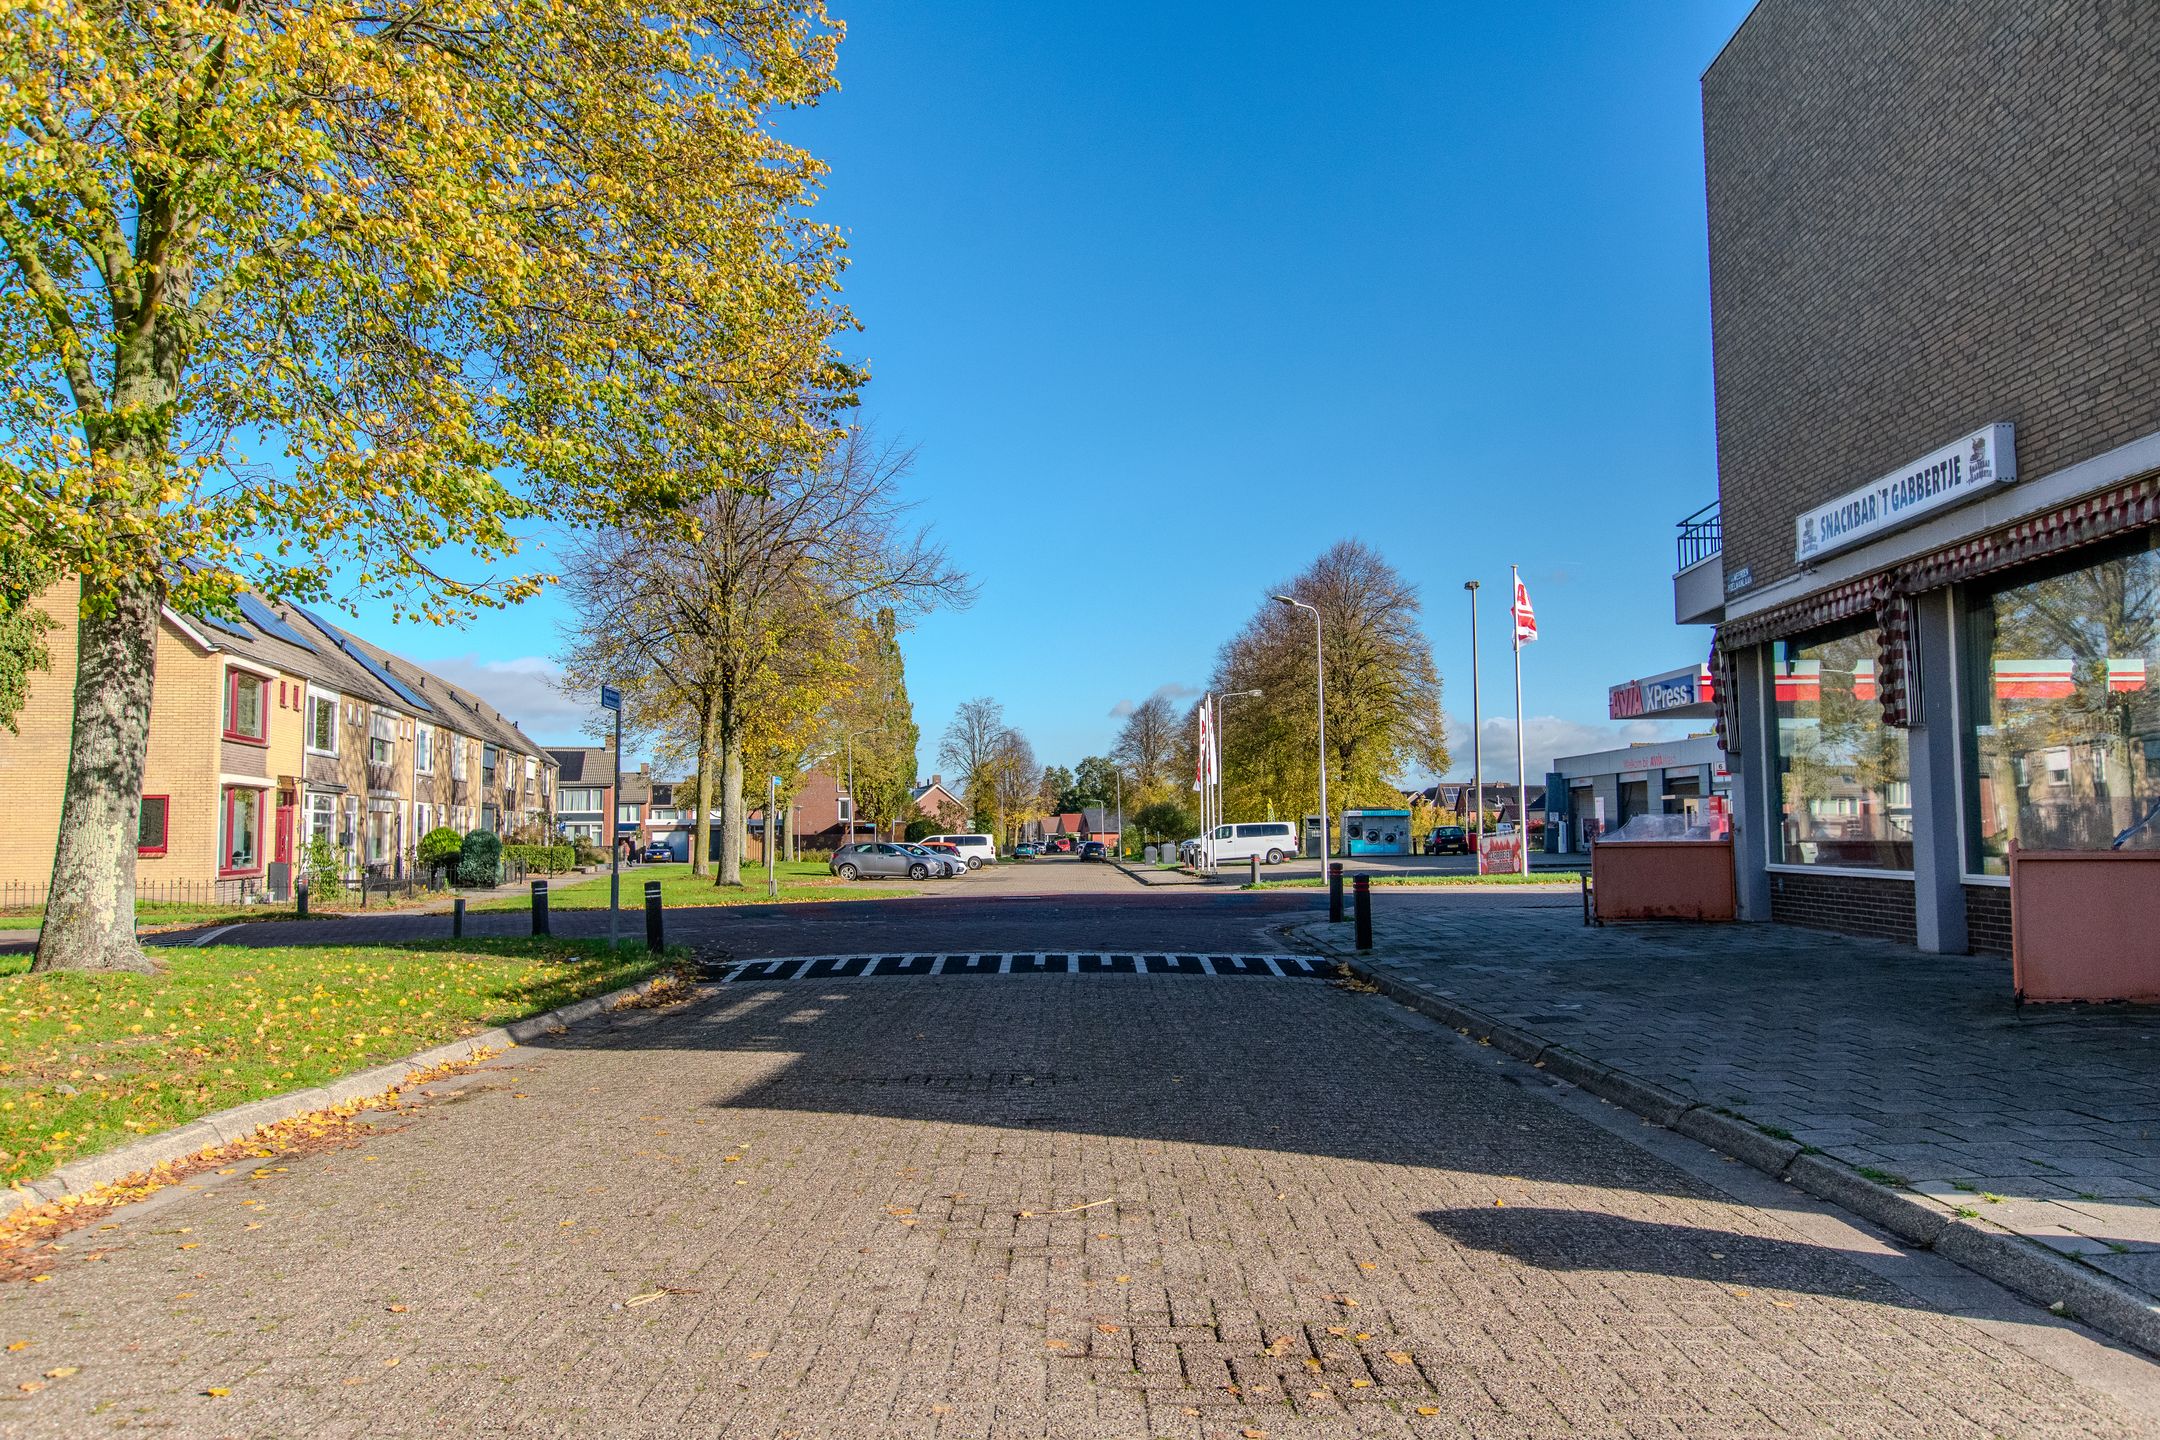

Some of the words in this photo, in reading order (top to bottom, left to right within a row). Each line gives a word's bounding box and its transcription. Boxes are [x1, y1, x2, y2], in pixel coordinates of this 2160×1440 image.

[1820, 494, 1876, 543] SNACKBAR
[1891, 455, 1961, 512] GABBERTJE
[1611, 680, 1644, 719] AVIA
[1646, 684, 1688, 711] XPress
